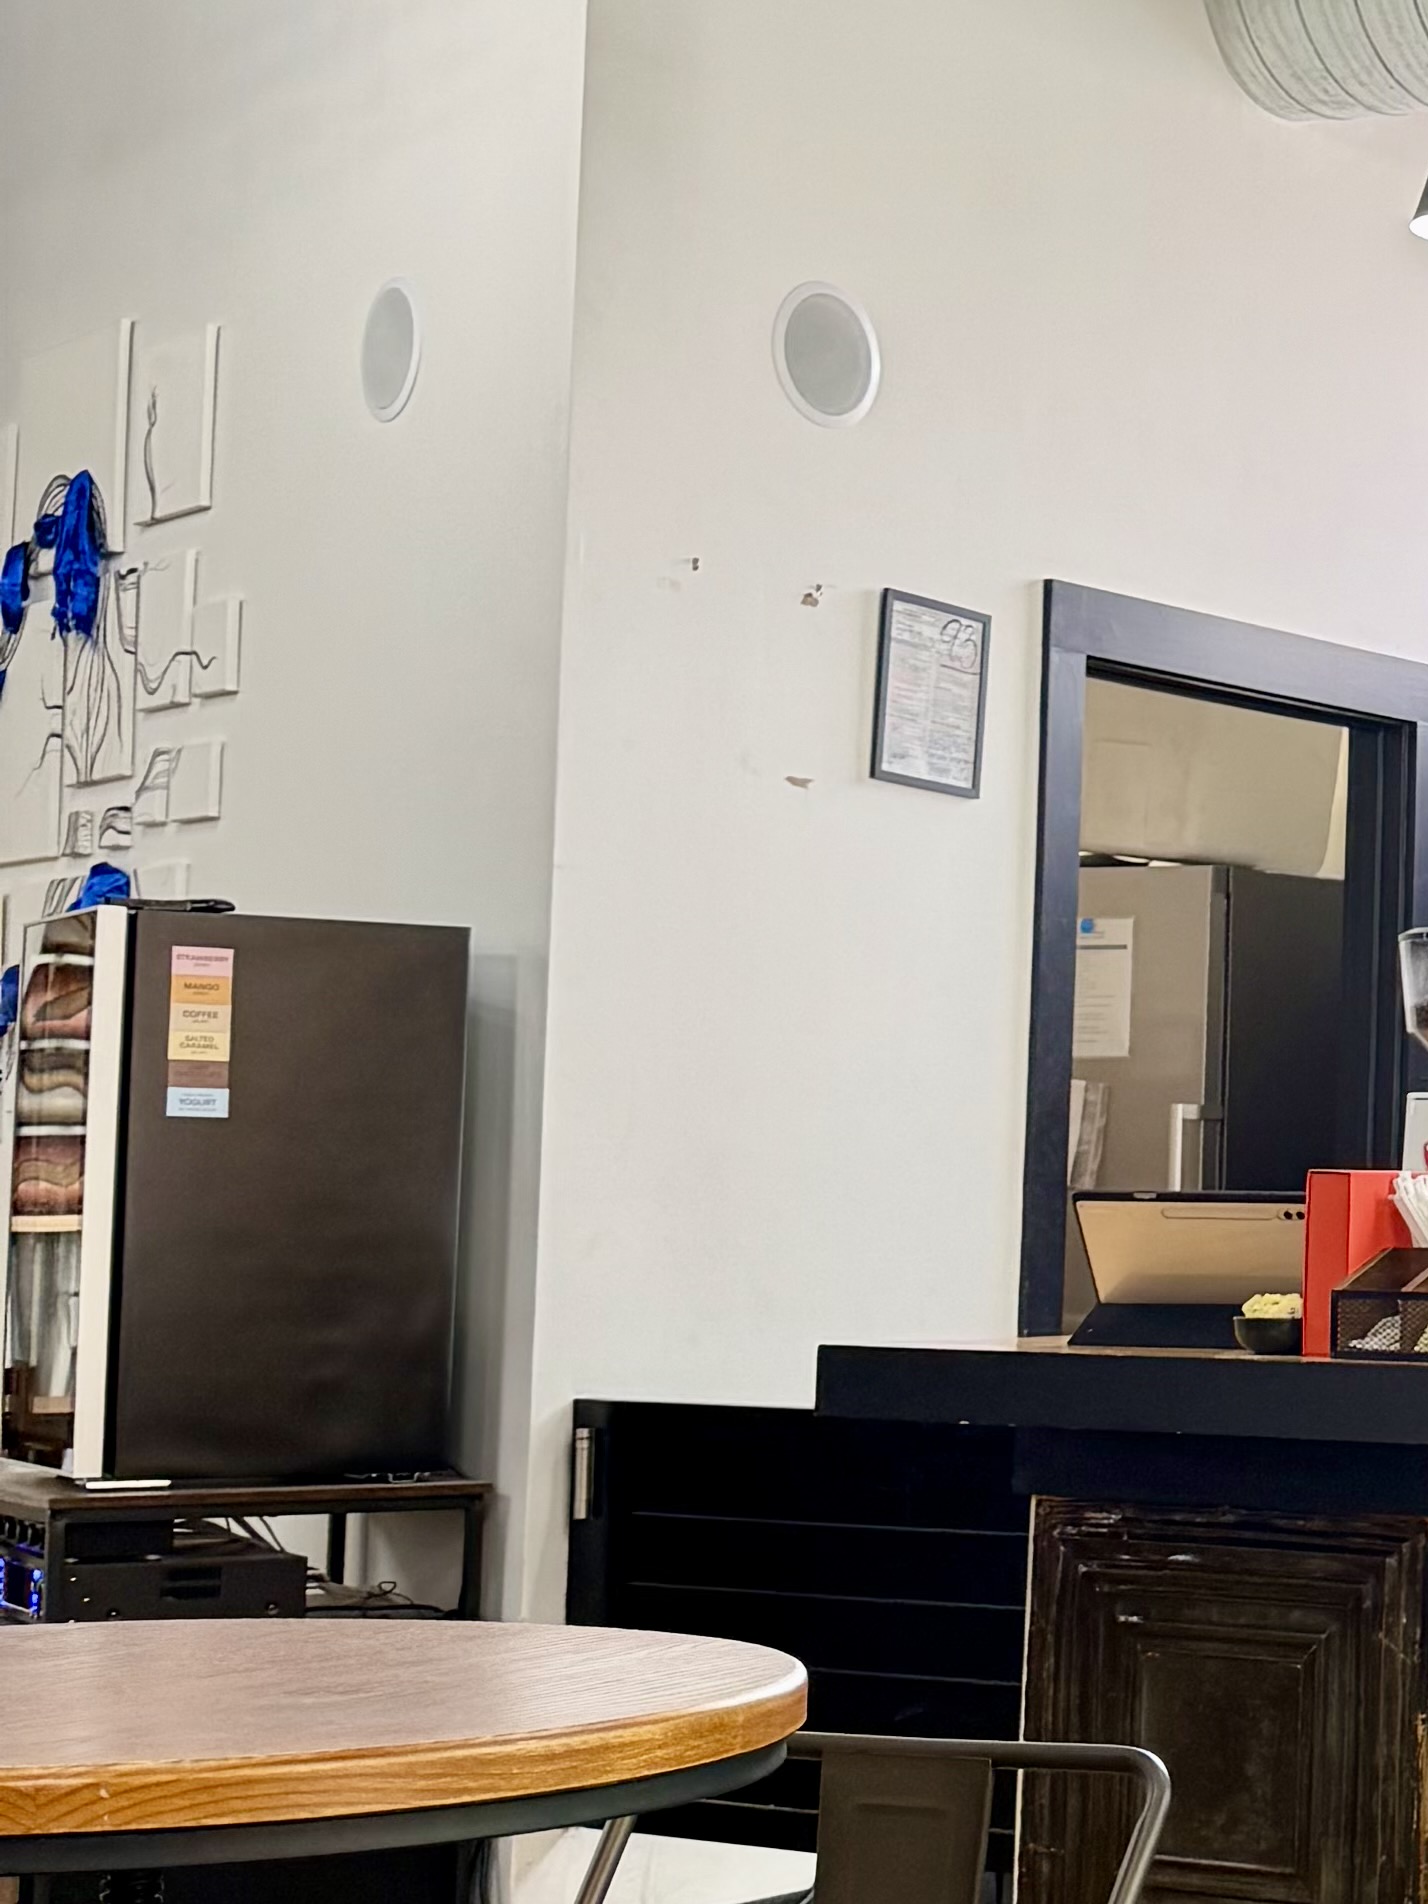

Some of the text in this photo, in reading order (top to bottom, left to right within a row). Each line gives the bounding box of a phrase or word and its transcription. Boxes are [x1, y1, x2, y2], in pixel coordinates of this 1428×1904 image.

[940, 618, 978, 669] 93
[184, 982, 220, 991] MANGO
[182, 1010, 219, 1019] COFFEE
